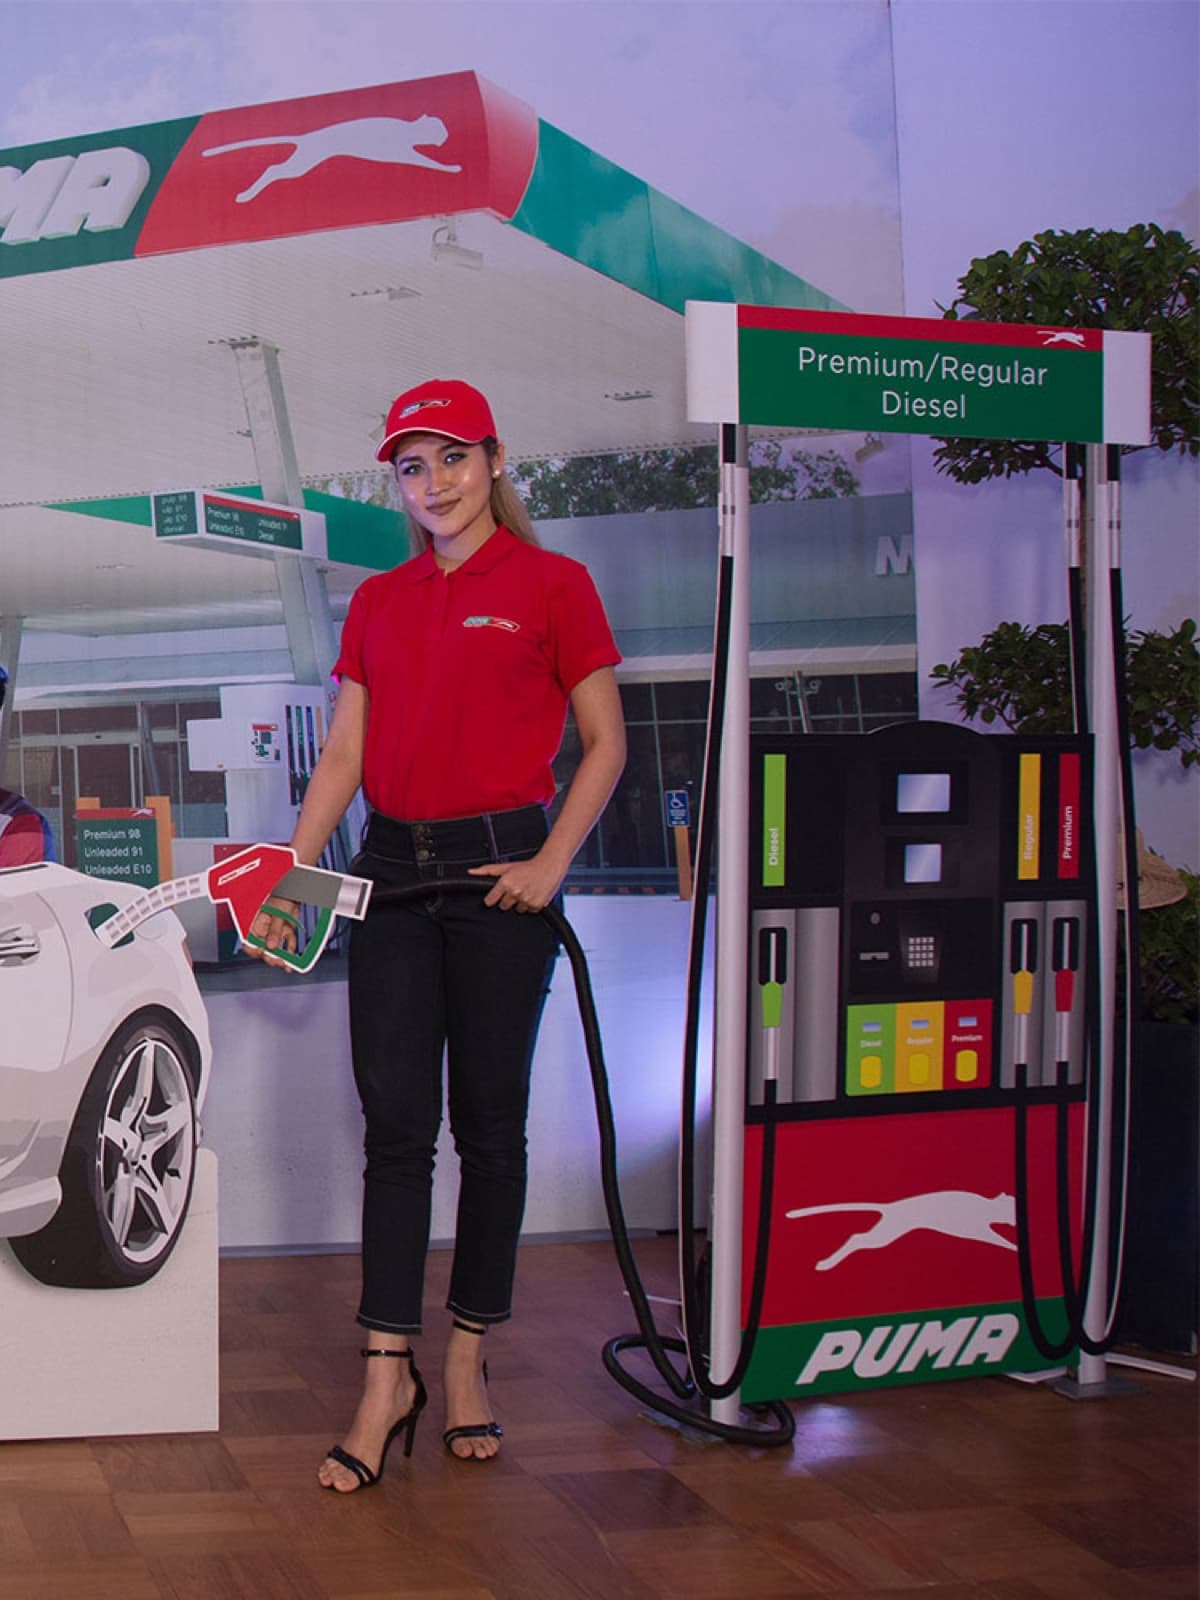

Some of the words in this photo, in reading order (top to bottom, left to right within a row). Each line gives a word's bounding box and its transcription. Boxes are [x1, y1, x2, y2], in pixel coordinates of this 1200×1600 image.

[798, 346, 1049, 387] Premium/Regular
[881, 391, 967, 419] Diesel
[83, 829, 127, 840] Premium
[128, 828, 142, 840] 98
[84, 846, 130, 858] Unleaded
[131, 846, 144, 858] 91
[767, 827, 780, 867] Diesel
[1023, 813, 1035, 860] Regular
[1062, 805, 1074, 859] Premium
[84, 863, 131, 875] Unleaded
[133, 863, 153, 875] E10
[794, 1312, 1020, 1385] PUMA
